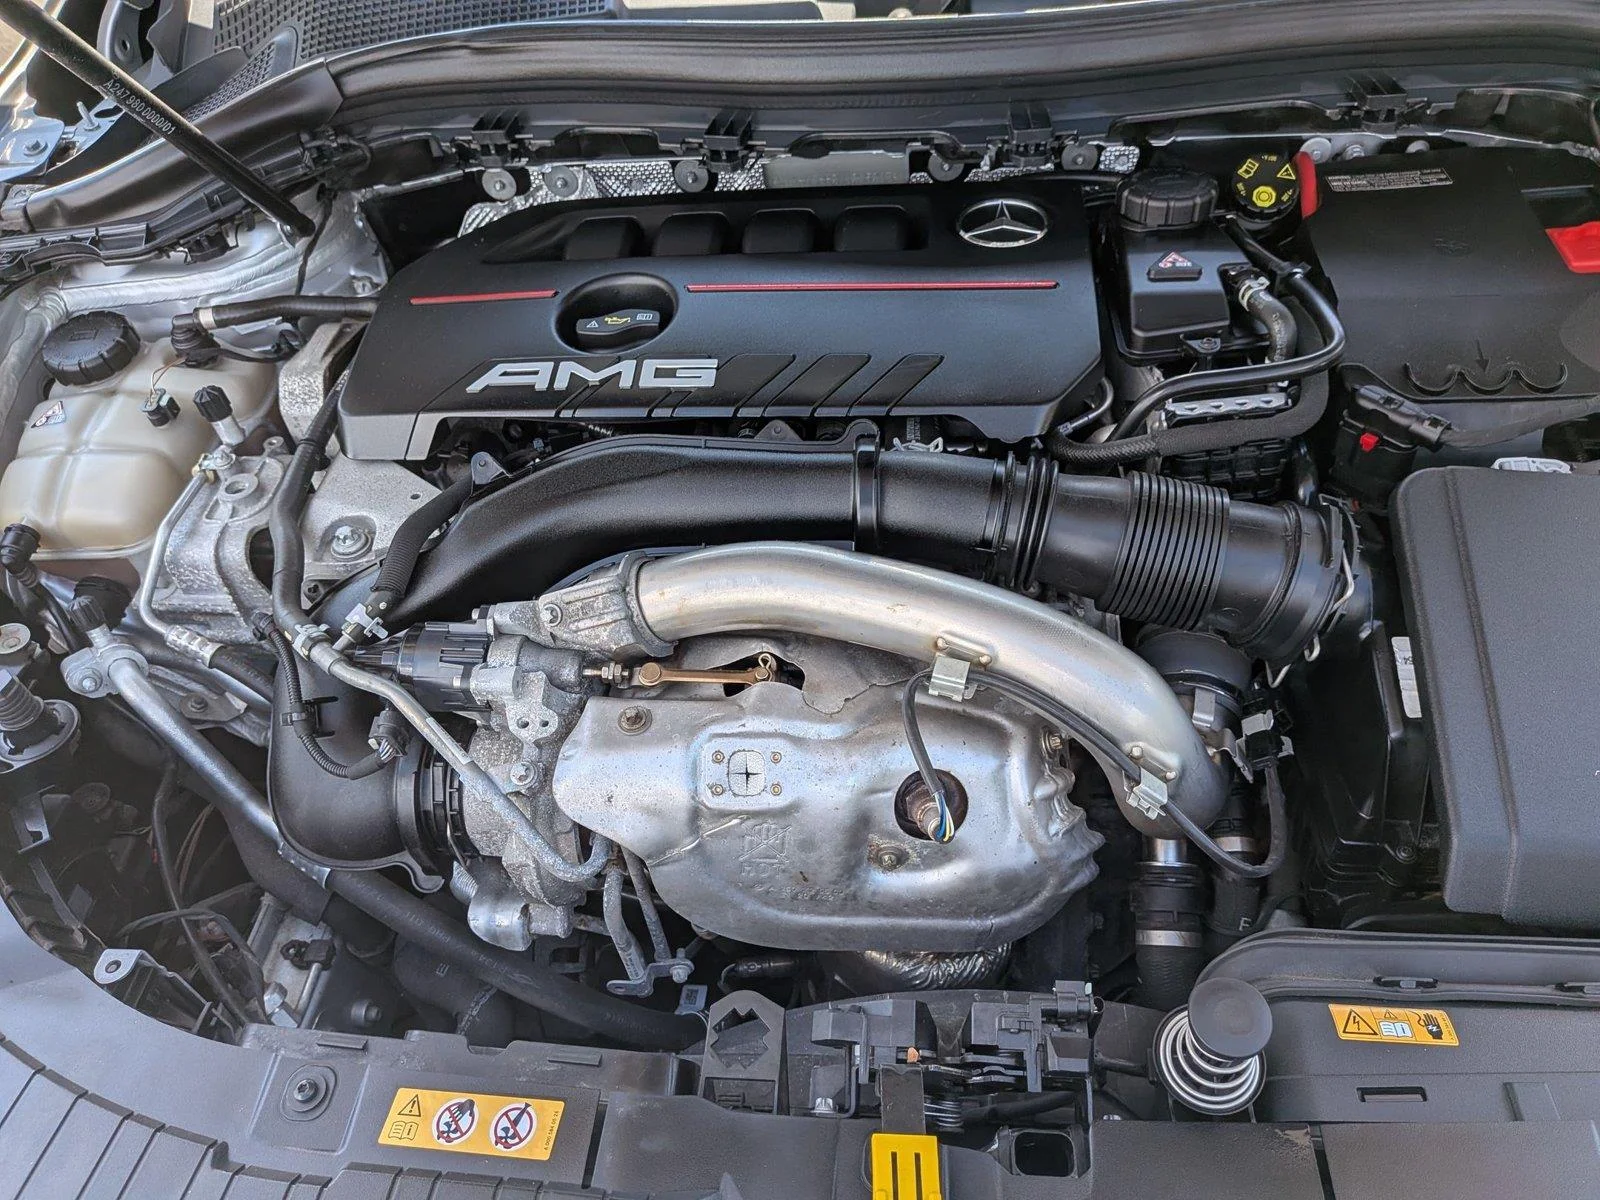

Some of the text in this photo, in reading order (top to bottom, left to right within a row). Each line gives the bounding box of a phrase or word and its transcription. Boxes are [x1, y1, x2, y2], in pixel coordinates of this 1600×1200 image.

[103, 79, 130, 99] A247
[126, 95, 145, 112] 980
[465, 359, 719, 393] AMG
